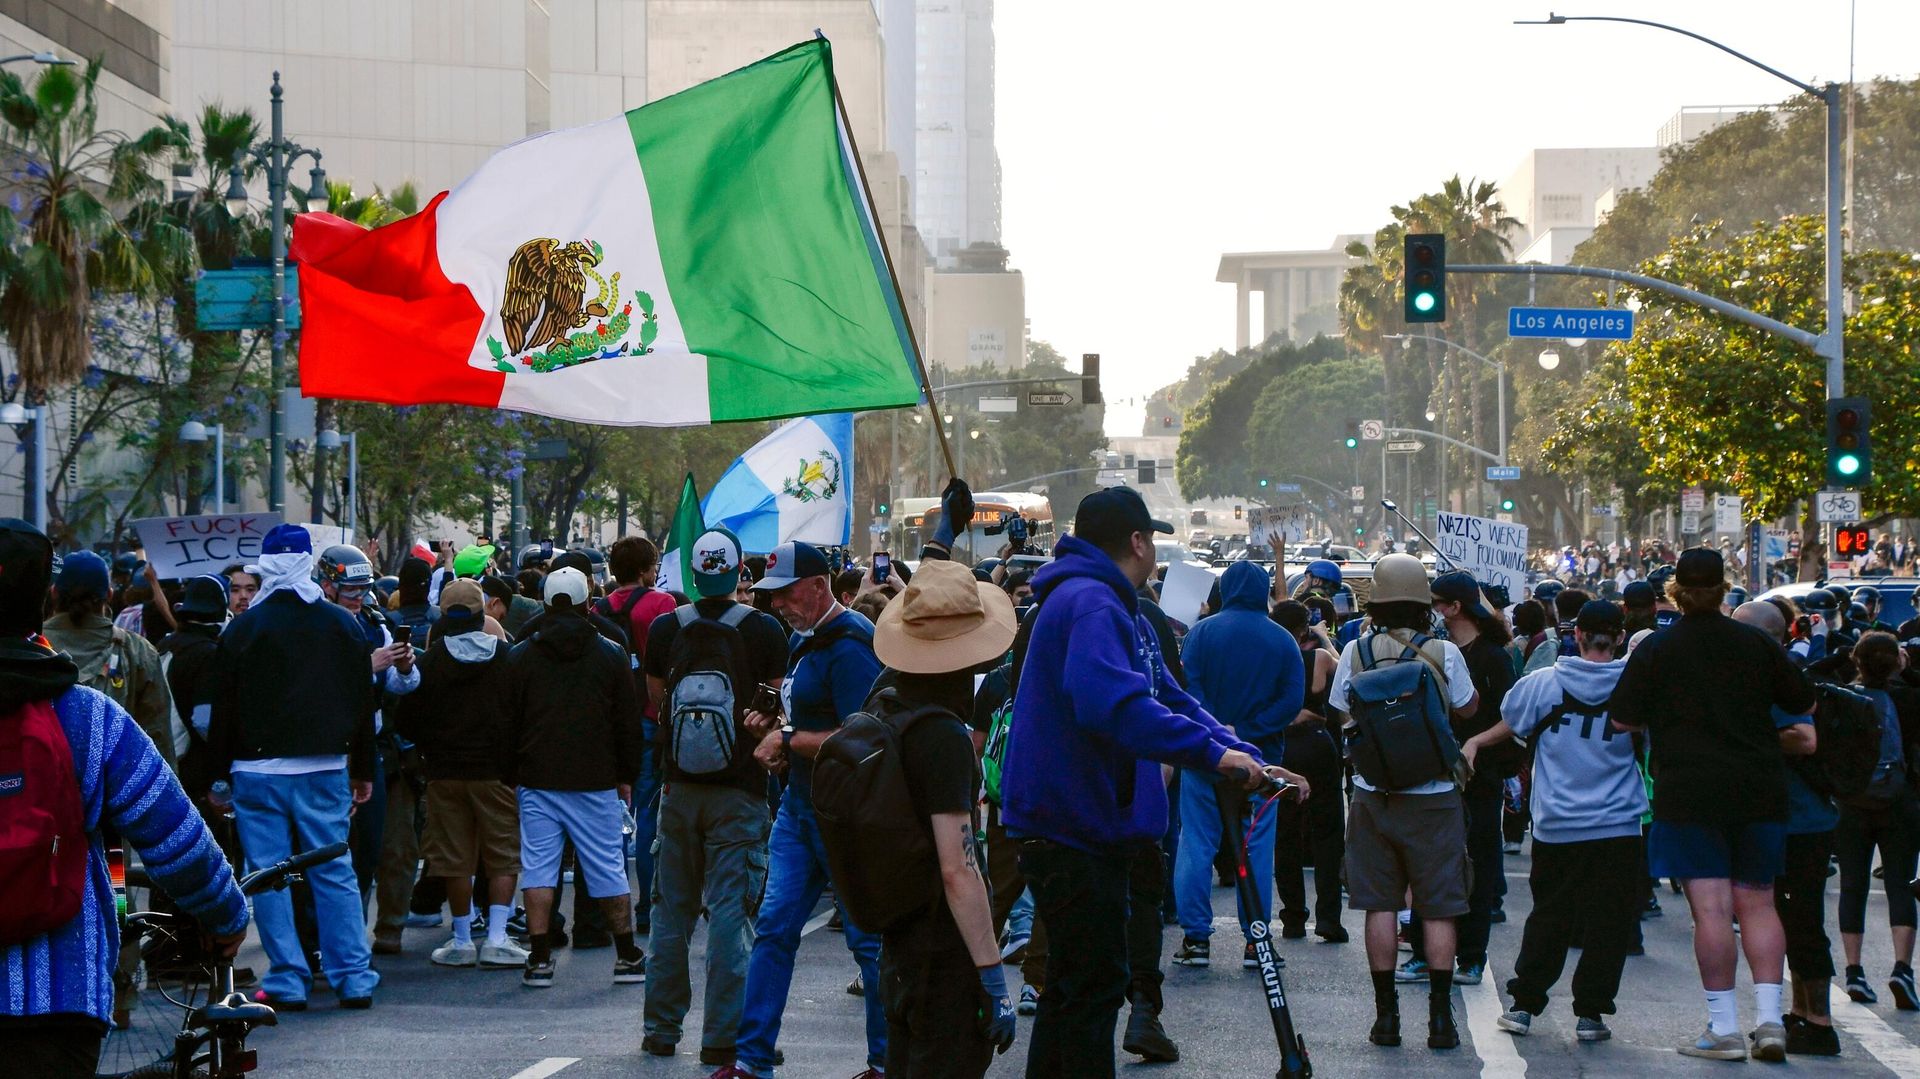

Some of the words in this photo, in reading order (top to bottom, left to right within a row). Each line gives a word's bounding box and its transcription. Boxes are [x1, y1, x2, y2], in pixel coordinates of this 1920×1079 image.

[1516, 313, 1545, 328] Los
[1553, 314, 1625, 334] Angeles
[165, 517, 263, 538] FUCK
[982, 511, 1000, 522] LINE
[1488, 523, 1525, 550] WERE
[1439, 536, 1467, 562] JUST
[1255, 940, 1285, 1009] ESKUTE
